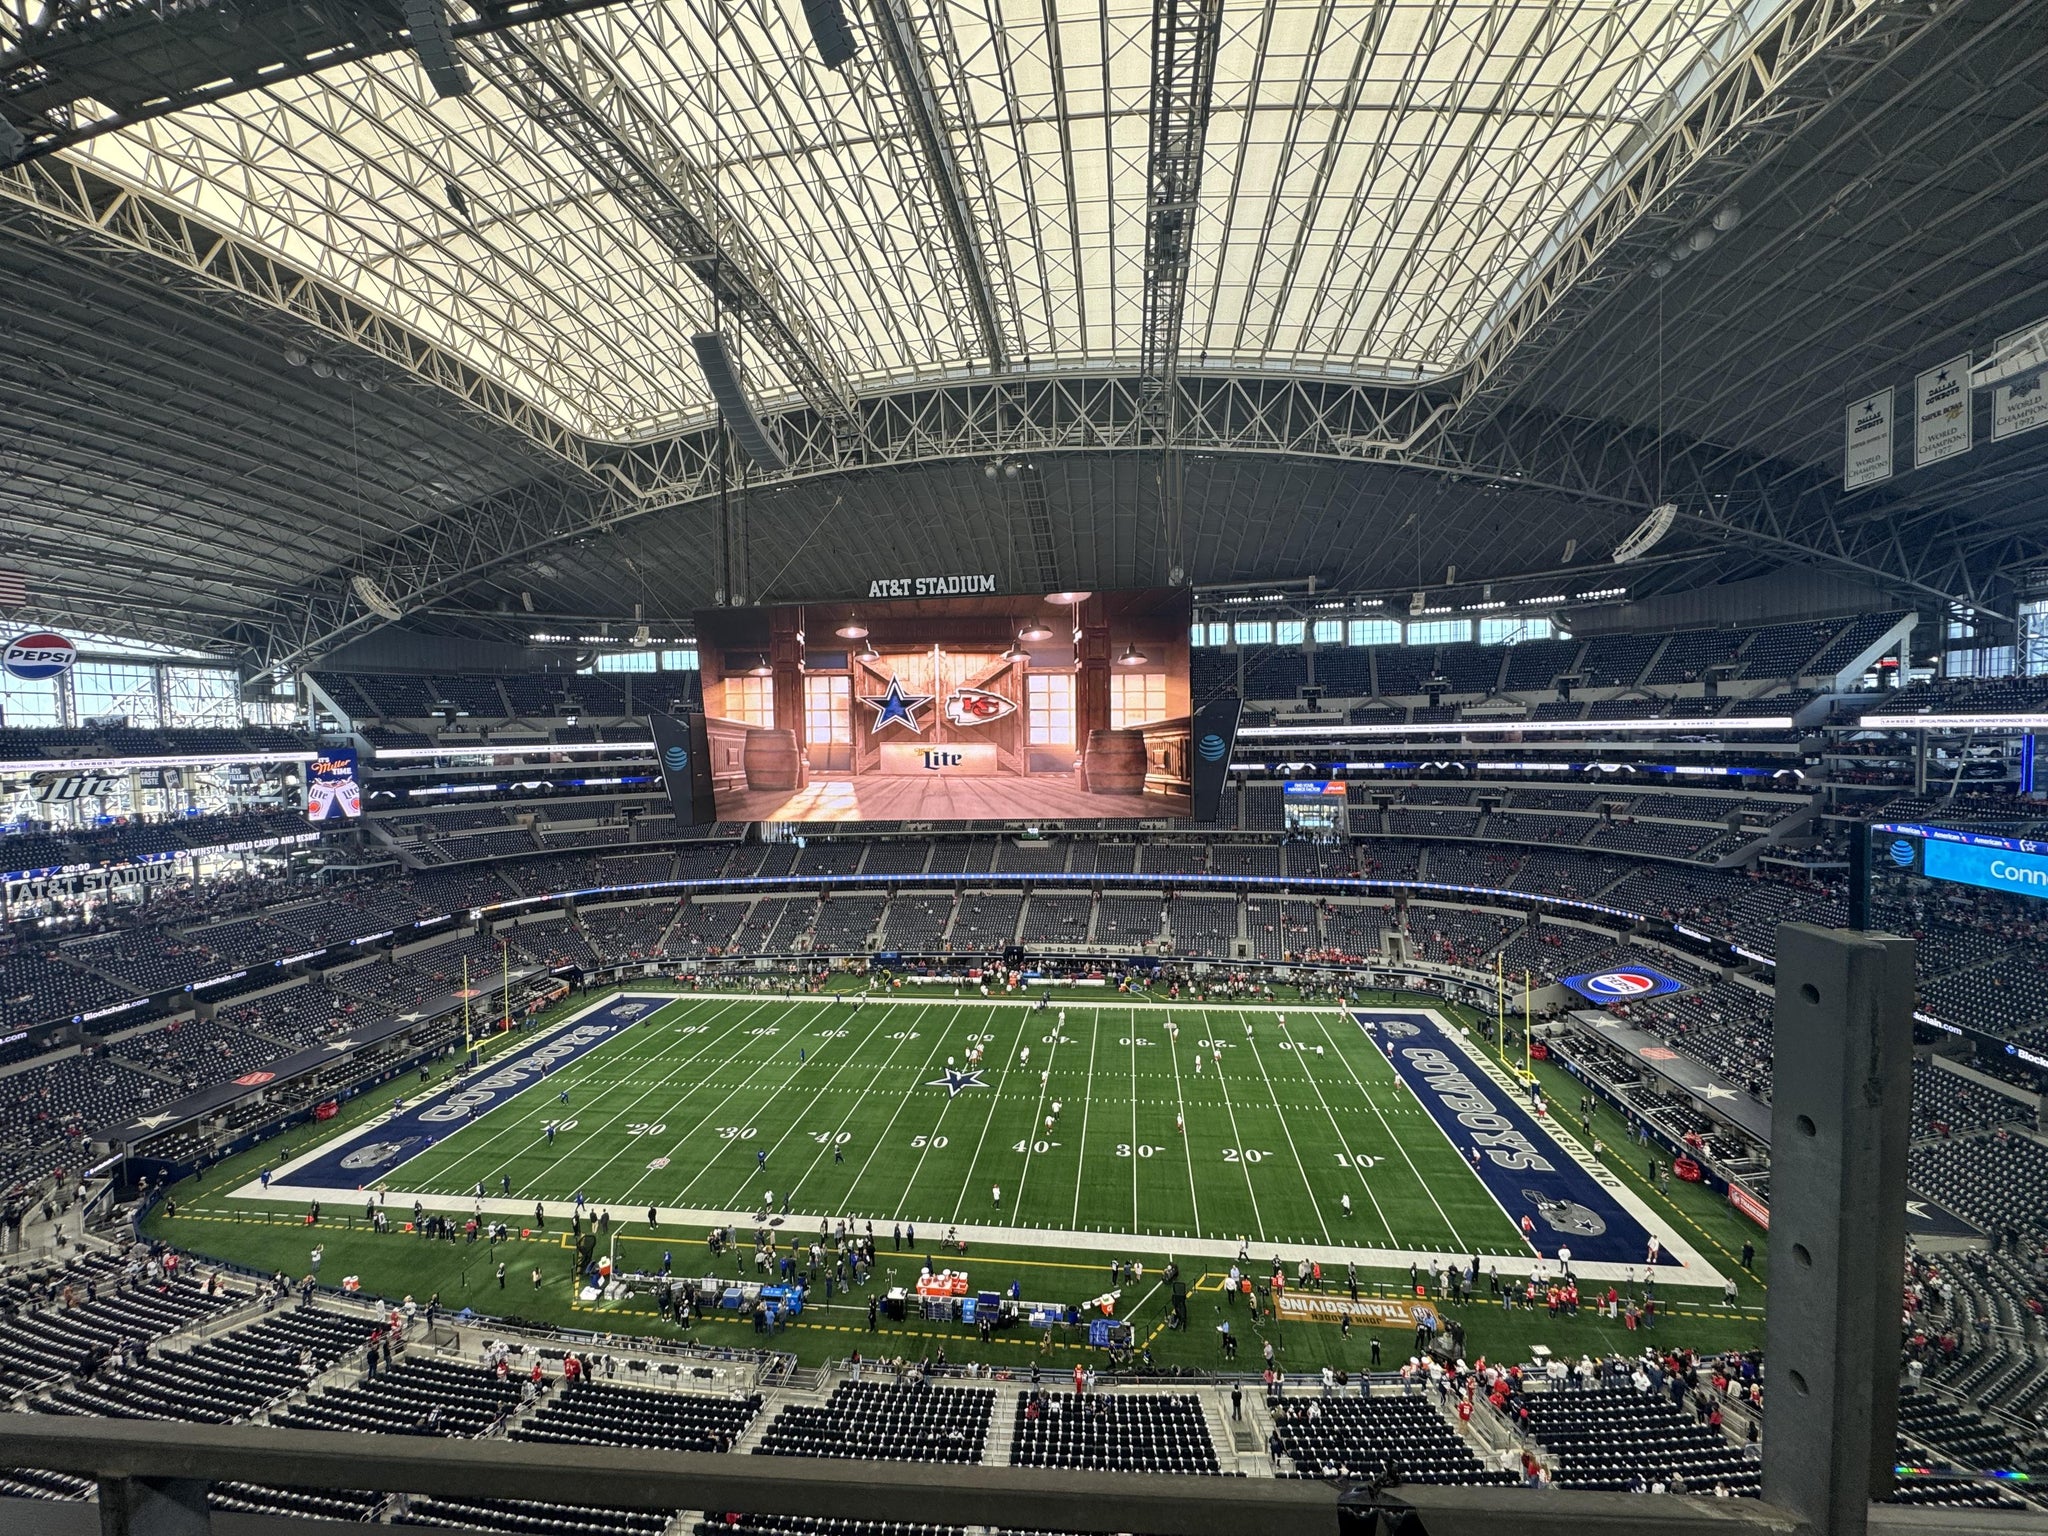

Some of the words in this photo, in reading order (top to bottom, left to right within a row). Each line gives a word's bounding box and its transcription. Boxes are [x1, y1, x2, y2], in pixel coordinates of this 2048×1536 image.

[1925, 386, 1960, 405] COWBOYS
[1928, 380, 1957, 397] DALLAS
[2006, 396, 2043, 412] WORLD
[1857, 411, 1881, 426] DALLAS
[1996, 404, 2048, 426] CHAMPION
[1854, 417, 1884, 434] COWBOYS
[1928, 427, 1958, 442] WORLD
[1919, 432, 1967, 454] CHAMPIONS
[1848, 460, 1888, 478] CHAMPIONS
[1855, 454, 1881, 468] WORLD
[868, 578, 912, 598] AT&T
[915, 574, 996, 596] STADIUM
[8, 649, 73, 663] PEPSI
[311, 759, 352, 775] Miller
[923, 751, 963, 770] Lite
[140, 770, 159, 778] GREAT
[332, 767, 353, 775] TIME
[35, 777, 121, 804] Lite
[309, 788, 329, 800] Lite
[342, 786, 360, 799] Lite
[1896, 825, 1921, 836] American
[1933, 831, 1960, 841] American
[1974, 837, 2003, 846] American
[190, 845, 225, 857] WINSTAR
[227, 841, 253, 853] WORLD
[254, 838, 279, 849] CASINO
[280, 835, 295, 845] AND
[296, 832, 321, 842] RESORT
[62, 863, 91, 873] 90:00
[1990, 860, 2048, 886] Conn
[17, 877, 77, 901] AT&T
[83, 864, 178, 892] STADIUM
[356, 930, 394, 944] Blockchain.com
[282, 949, 327, 965] Blockchain.com
[193, 970, 247, 990] Blockchain.com
[1602, 976, 1639, 992] PEPSI
[83, 998, 150, 1022] Blockchain.com
[1913, 1011, 1963, 1036] kchain.com
[418, 1025, 610, 1122] COWBOYS
[1458, 1043, 1487, 1061] JOHN
[1480, 1064, 1529, 1099] MADDEN
[1402, 1047, 1556, 1171] COWBOYS
[626, 1123, 667, 1136] 20
[719, 1126, 758, 1140] 30
[814, 1131, 852, 1144] 40
[910, 1135, 949, 1149] 50
[1011, 1139, 1050, 1153] 40
[1115, 1143, 1155, 1158] 30
[1221, 1148, 1263, 1163] 20
[1332, 1152, 1376, 1168] 10
[1279, 1297, 1409, 1319] THANKSGIVING
[1355, 1316, 1382, 1325] JOHN
